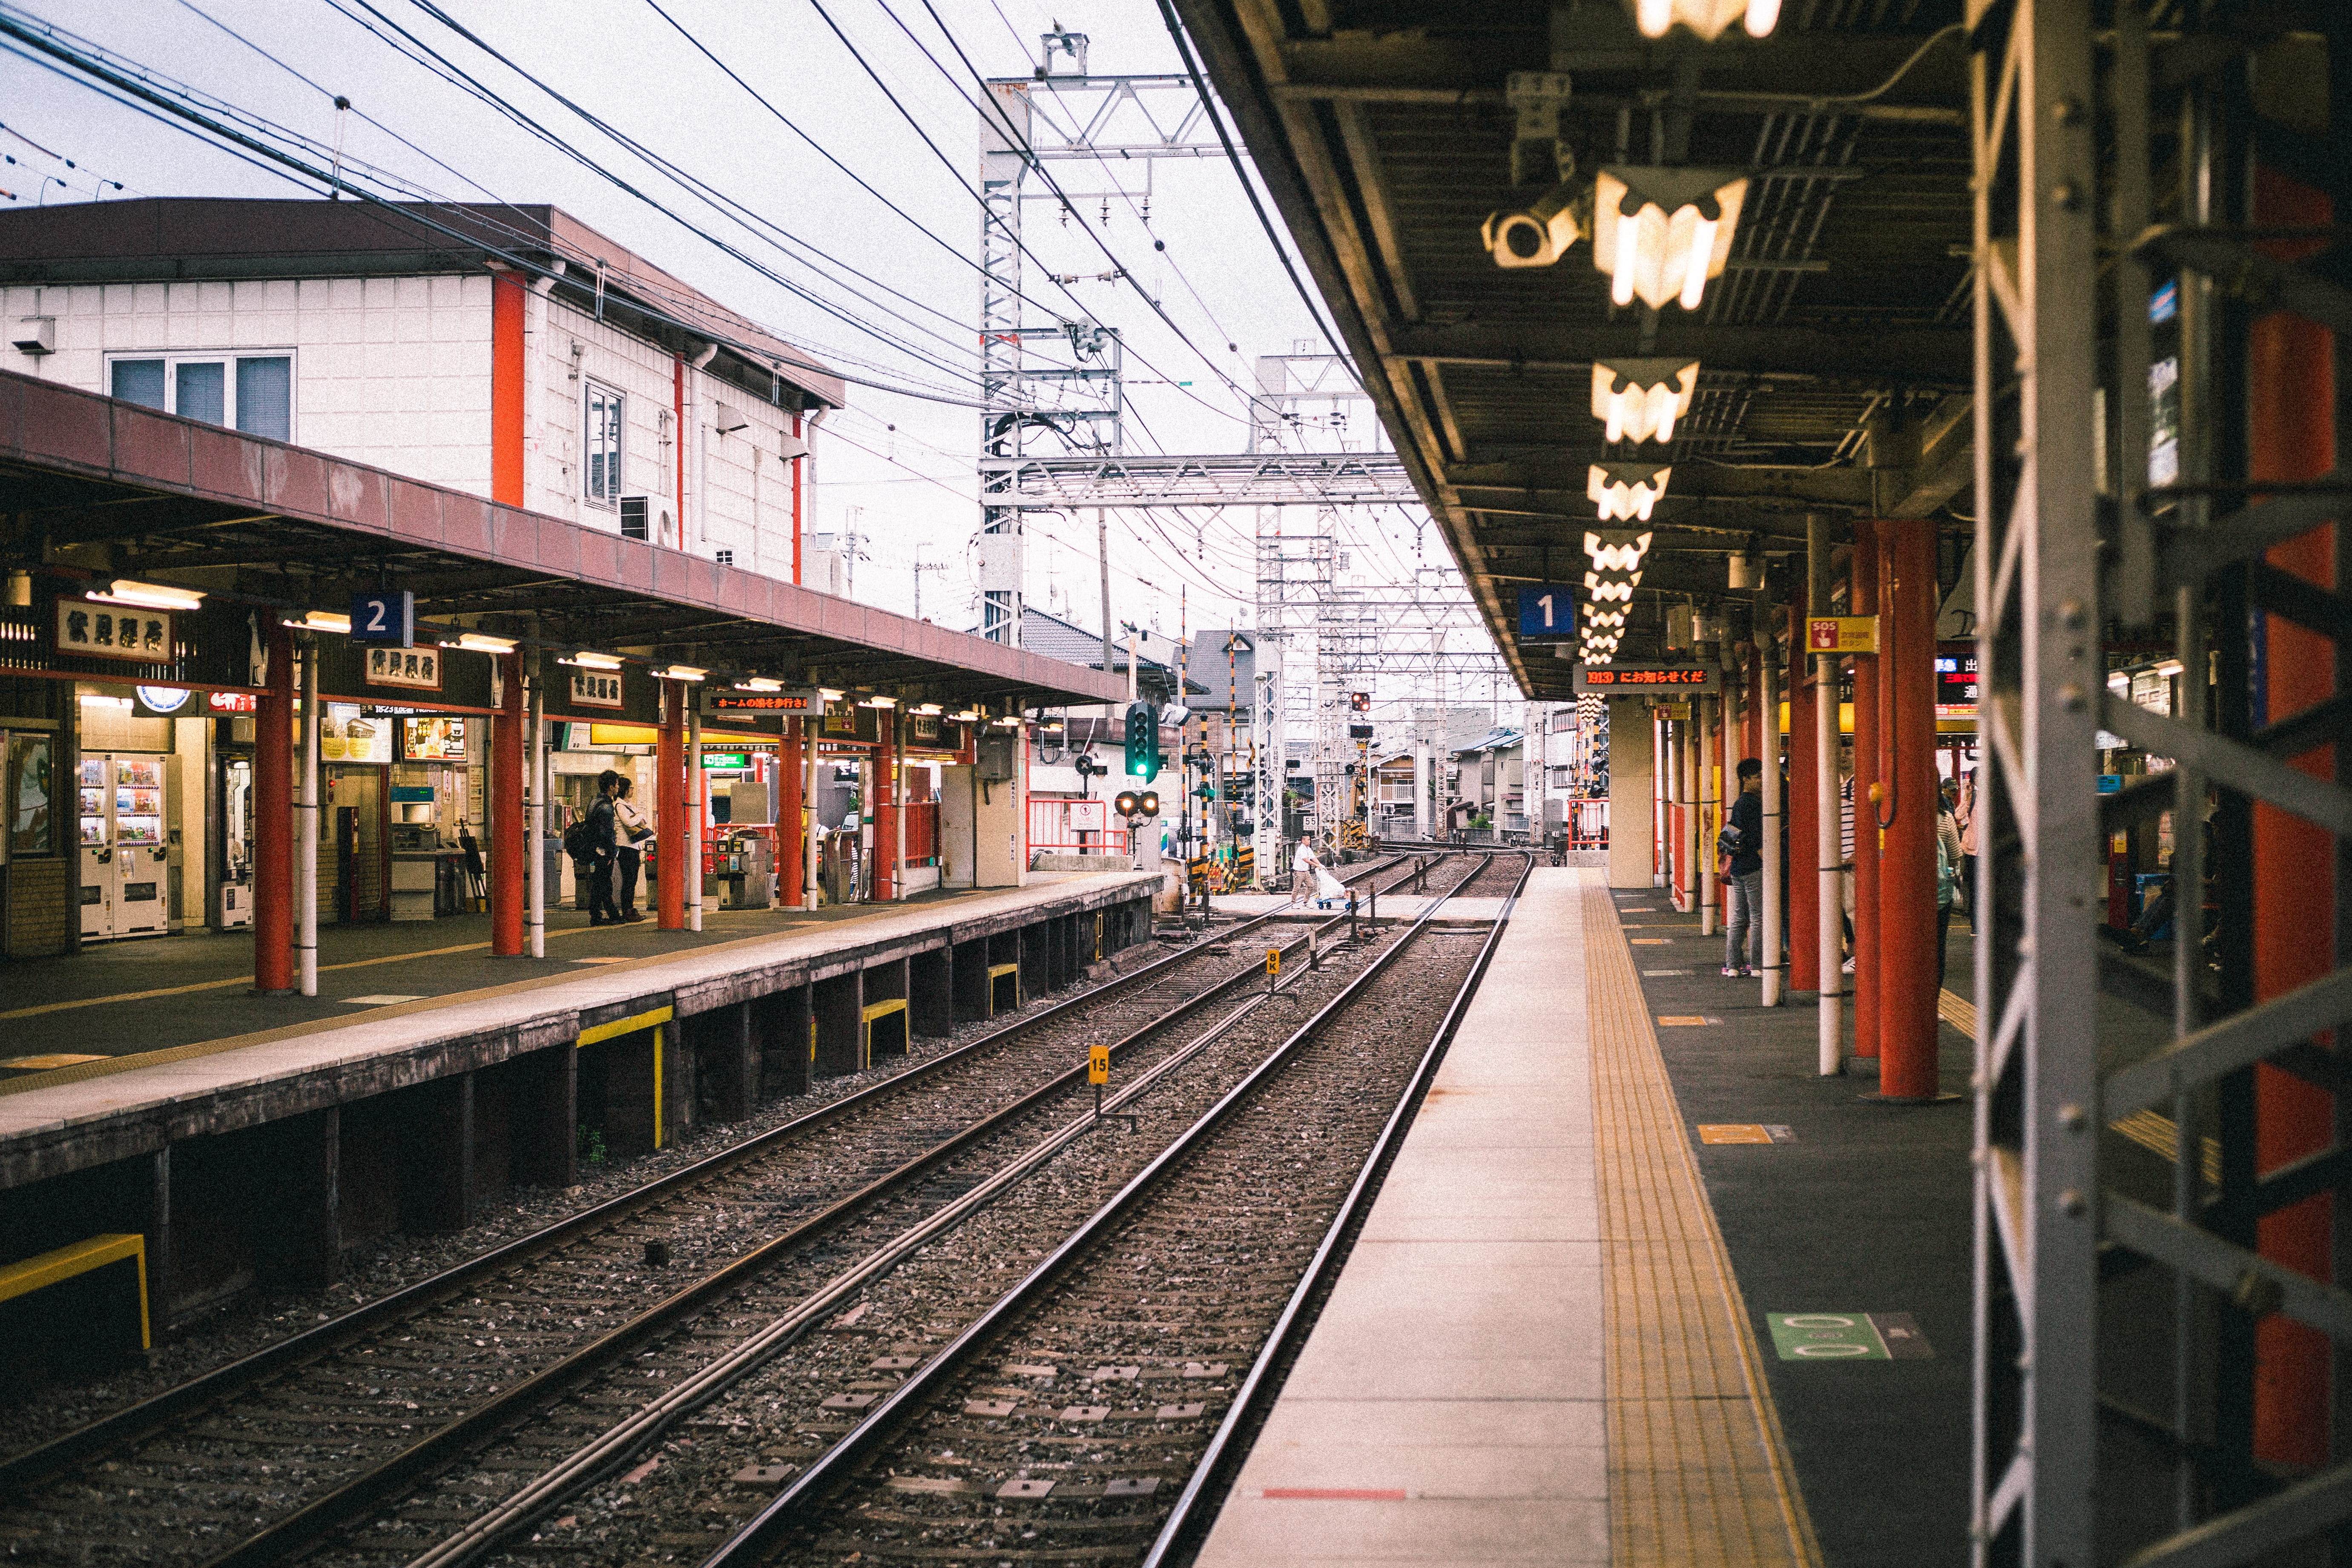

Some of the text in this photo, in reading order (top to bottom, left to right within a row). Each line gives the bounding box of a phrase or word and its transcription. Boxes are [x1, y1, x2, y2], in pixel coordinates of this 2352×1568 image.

[367, 600, 385, 631] 2
[1537, 595, 1553, 627] 1
[1812, 621, 1836, 631] SOS
[1965, 659, 1977, 672] 出
[1620, 670, 1706, 683] にお知らせくだ
[1269, 953, 1276, 962] 8
[1092, 1059, 1106, 1072] 15
